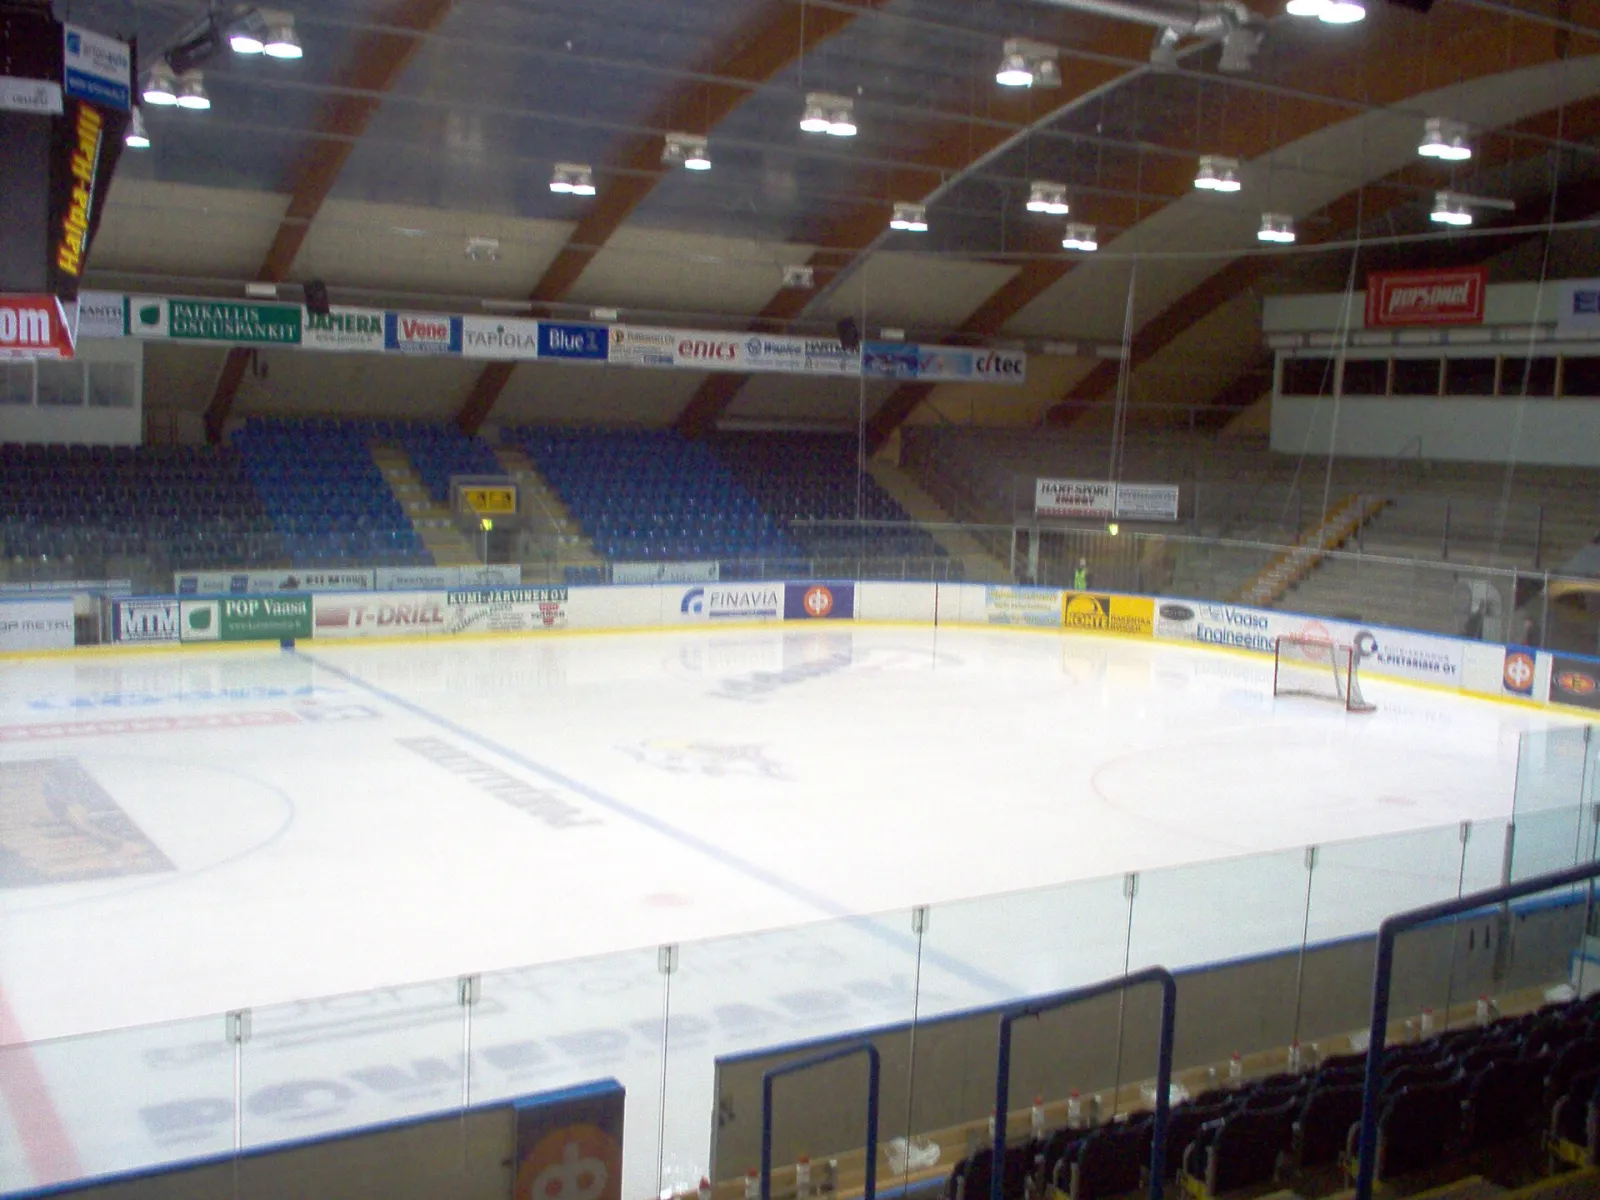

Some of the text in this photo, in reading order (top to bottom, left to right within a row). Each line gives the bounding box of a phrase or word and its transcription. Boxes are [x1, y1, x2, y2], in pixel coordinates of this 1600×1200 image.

[57, 102, 103, 276] Halpa-Halli
[173, 303, 260, 322] PAIKALLIS
[173, 318, 297, 342] OSUUSPANKIT
[465, 325, 536, 349] TAPIOLA
[225, 599, 307, 617] POP Vaasa
[710, 591, 779, 608] FINAVIA
[354, 602, 444, 627] T-DRILL
[1226, 606, 1269, 630] Vaasa
